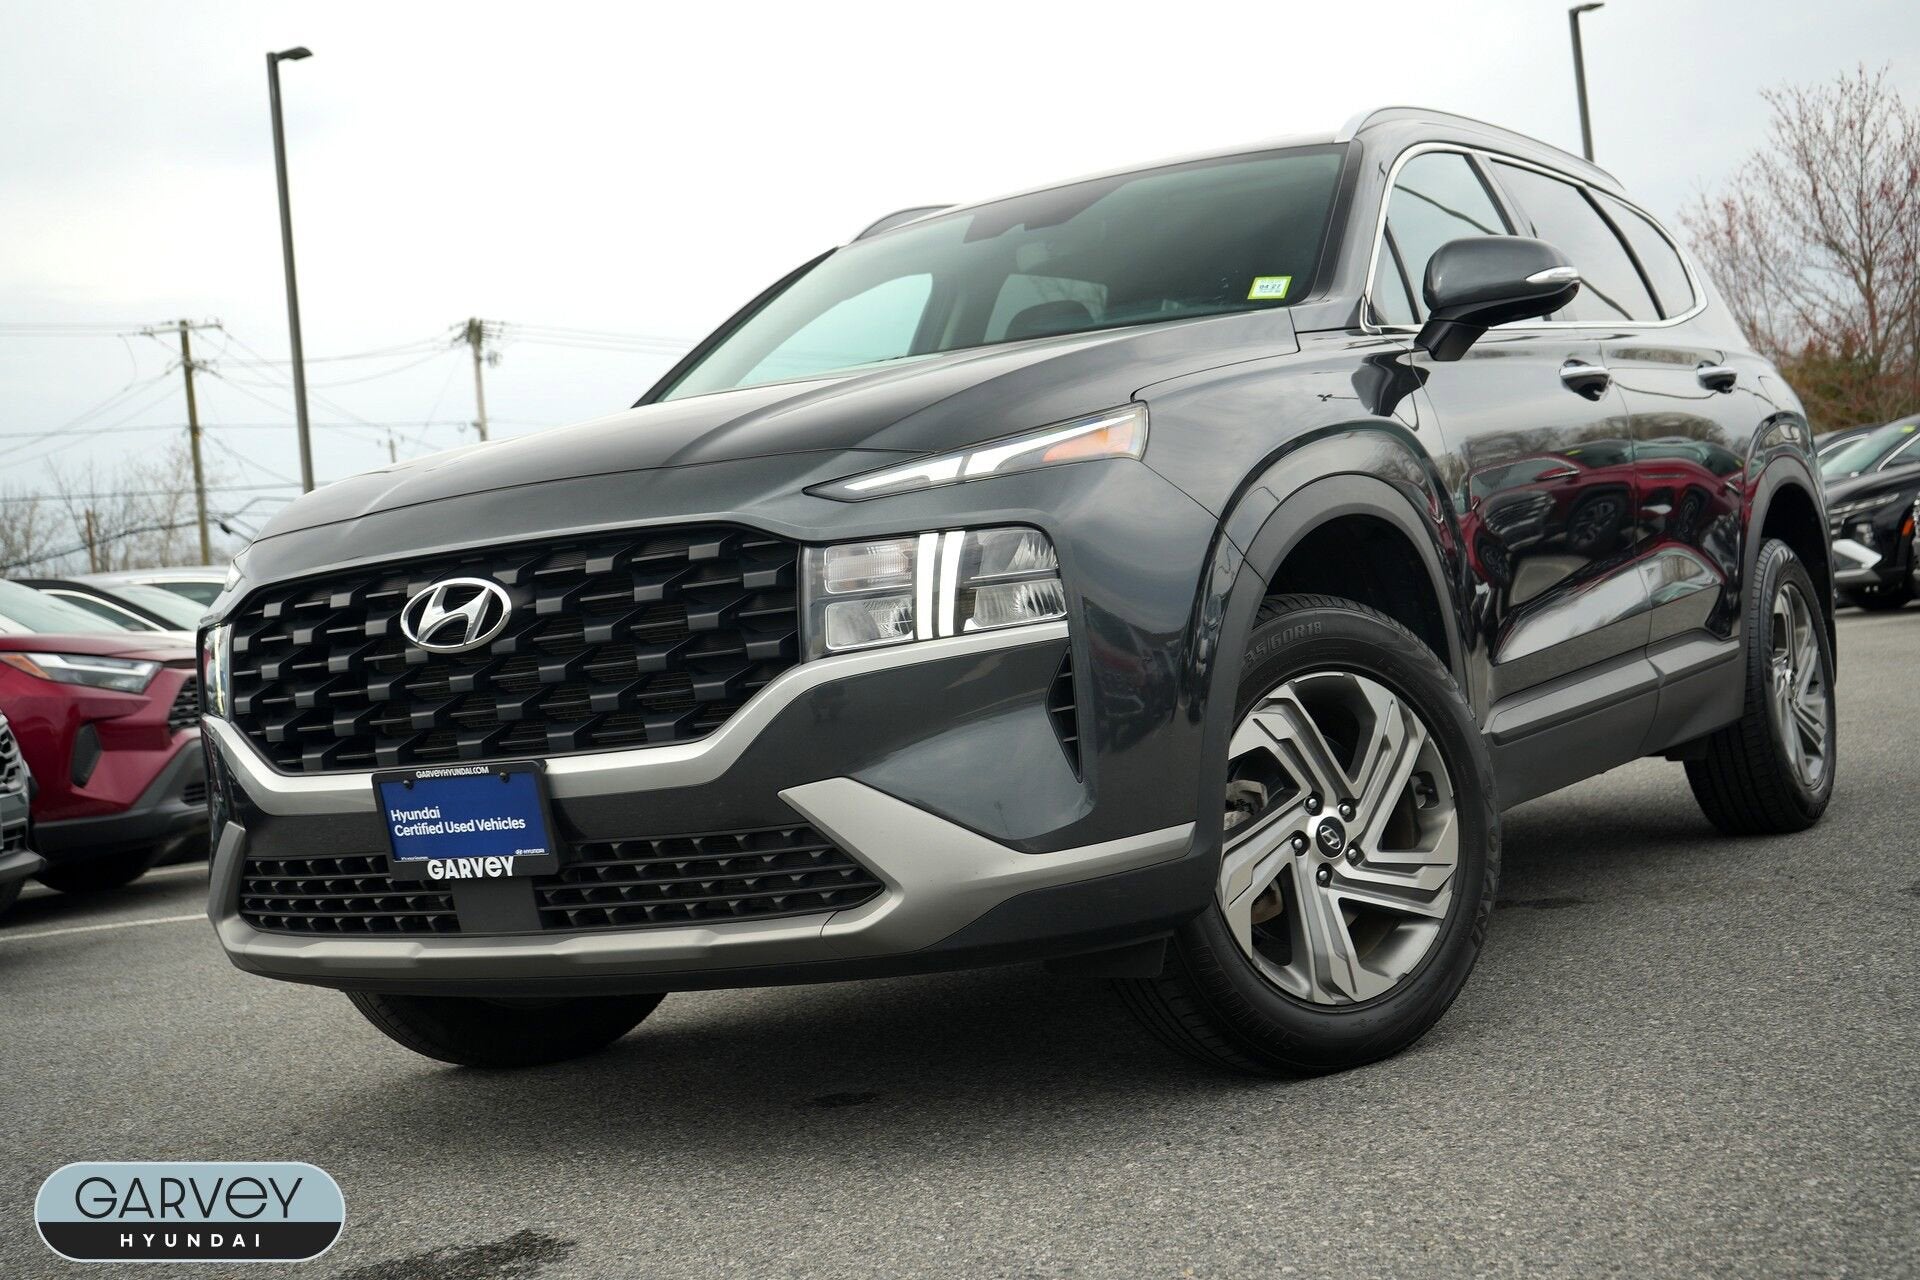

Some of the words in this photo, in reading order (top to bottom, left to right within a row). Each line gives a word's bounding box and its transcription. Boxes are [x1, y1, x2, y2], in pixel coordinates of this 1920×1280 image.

[1242, 621, 1322, 666] 35/60R18
[391, 806, 441, 823] Hyundai
[394, 822, 444, 837] Certified
[445, 819, 475, 834] Used
[475, 816, 526, 832] Vehicles
